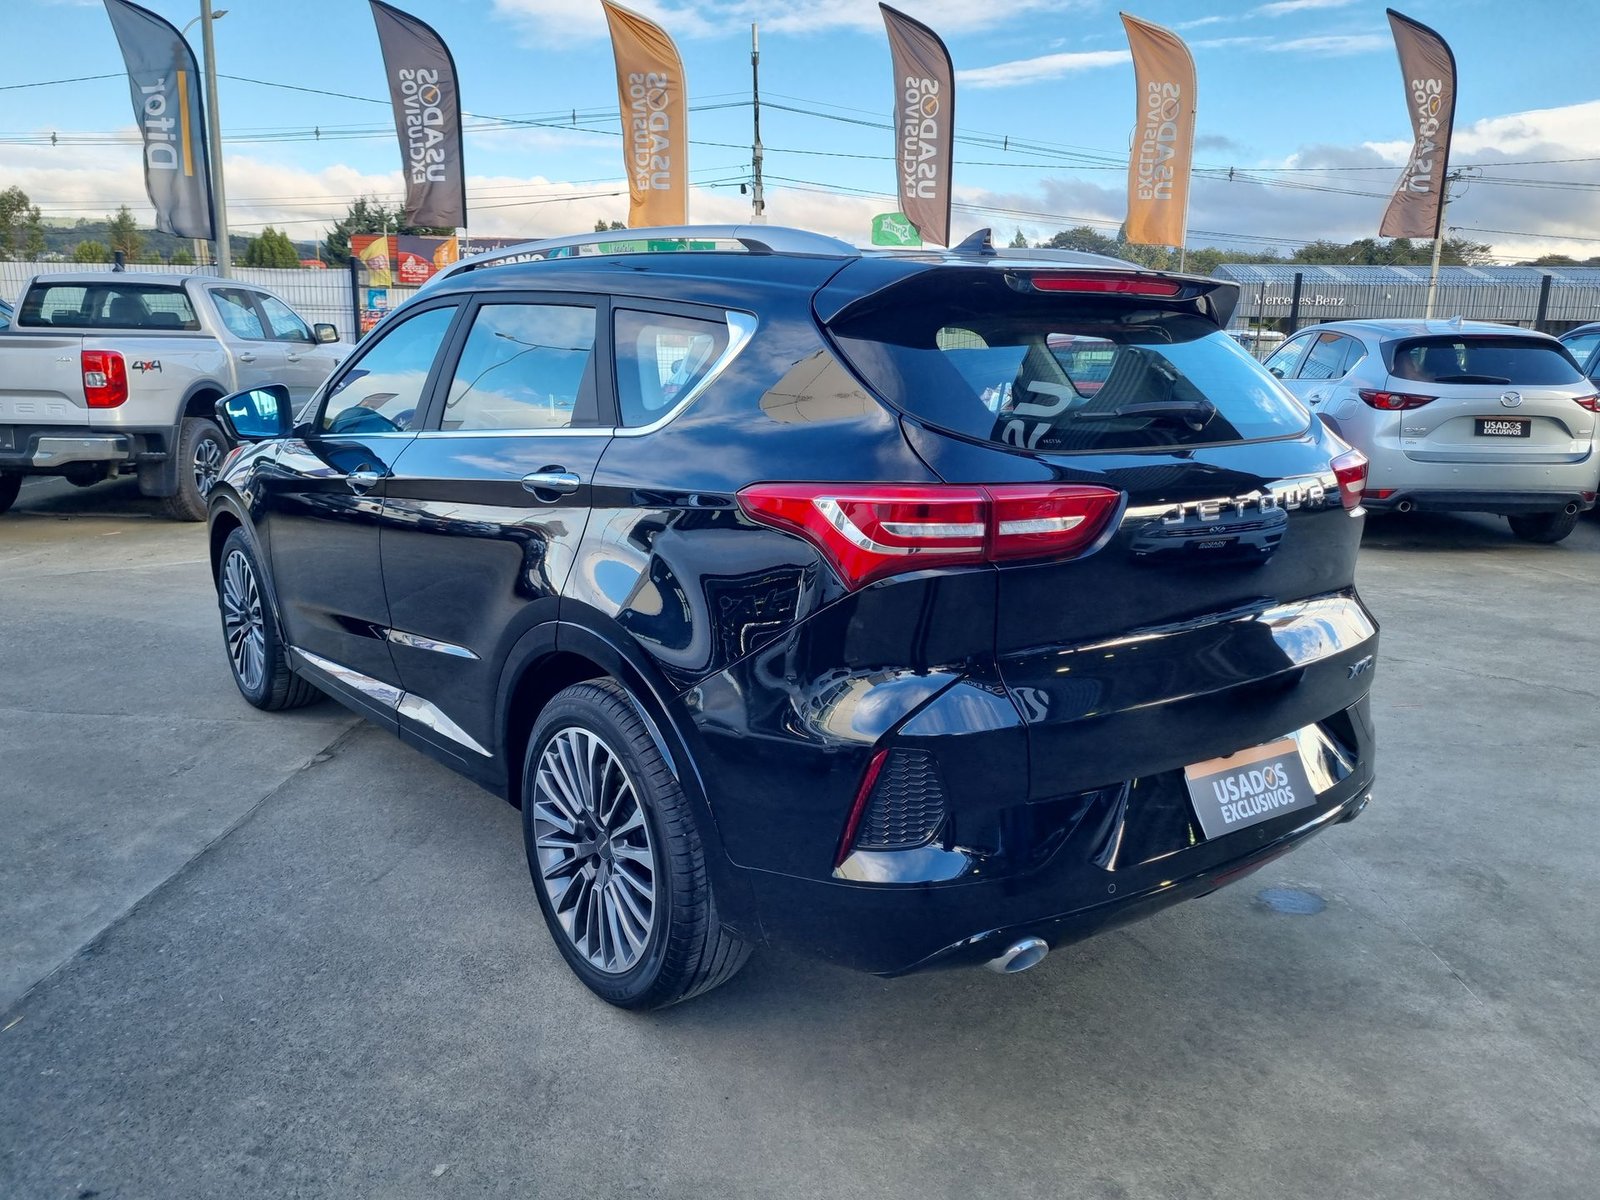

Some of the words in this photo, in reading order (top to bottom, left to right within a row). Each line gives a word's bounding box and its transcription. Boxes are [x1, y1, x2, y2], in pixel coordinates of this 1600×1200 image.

[1253, 293, 1345, 306] Mercees-Benz
[1484, 421, 1522, 430] USADOS
[1161, 486, 1325, 525] JETOUR
[1212, 762, 1289, 804] USADOS
[1220, 786, 1296, 824] EXCLUSIVOS
